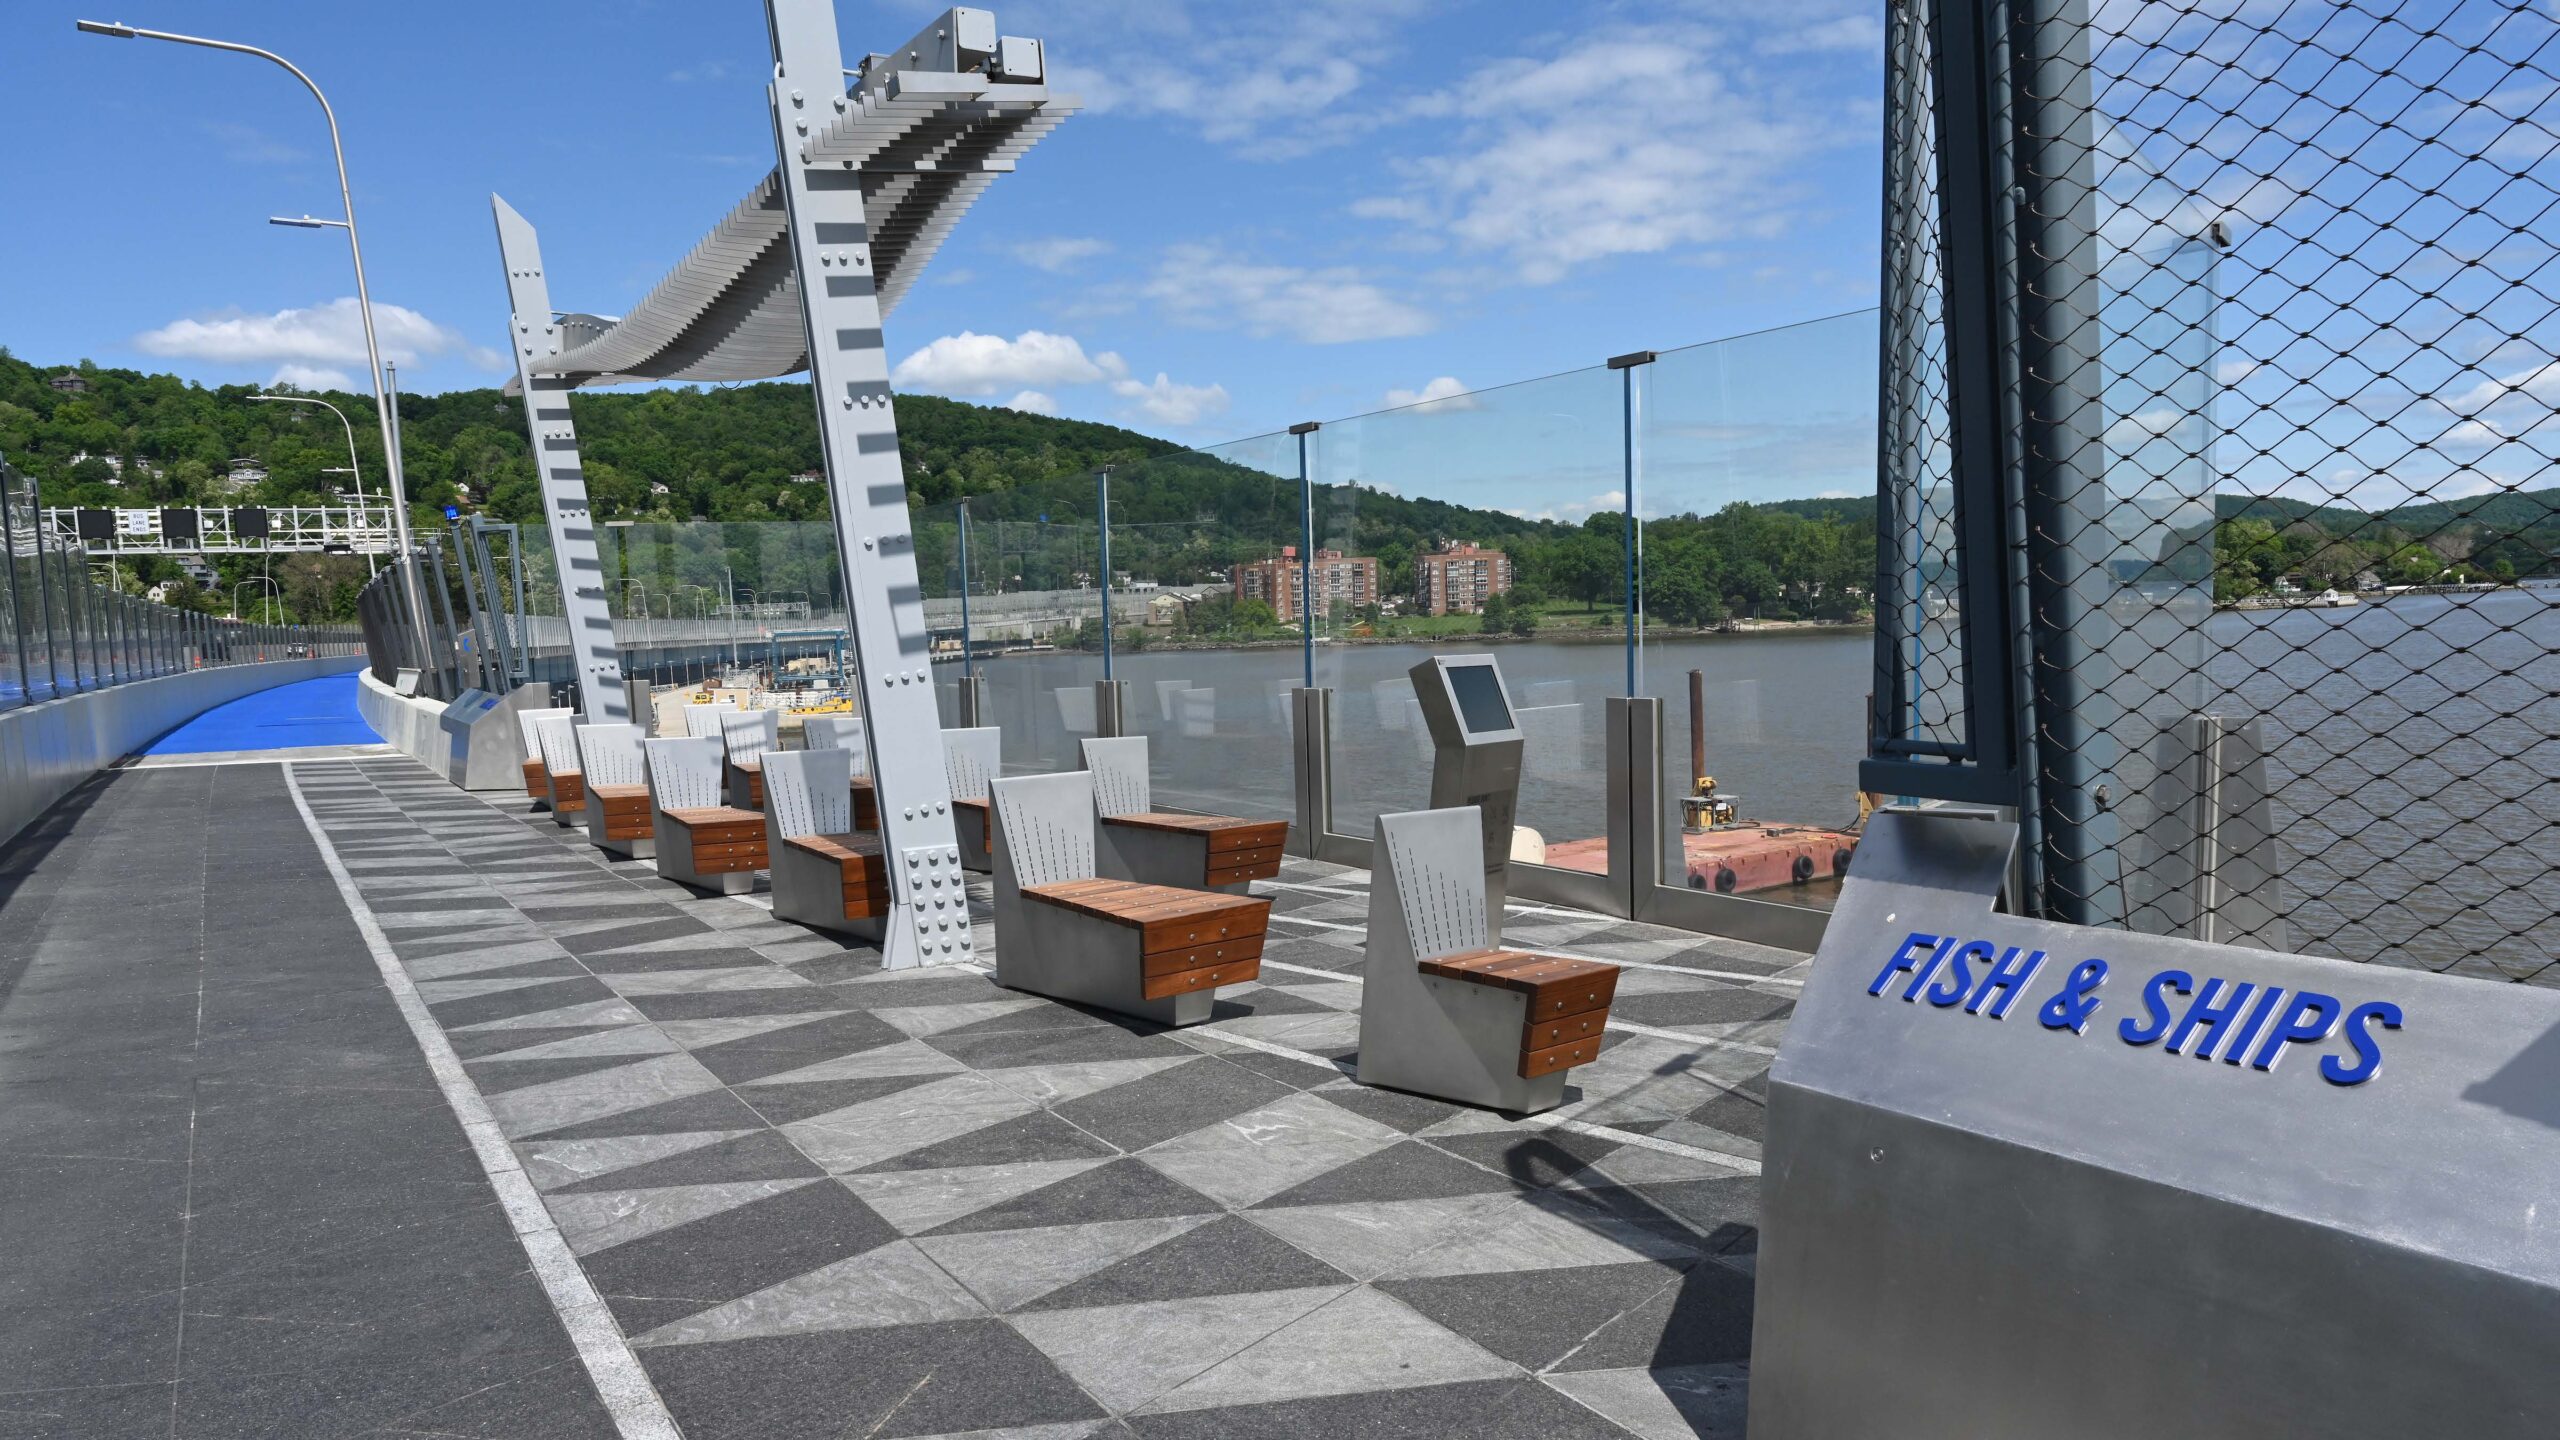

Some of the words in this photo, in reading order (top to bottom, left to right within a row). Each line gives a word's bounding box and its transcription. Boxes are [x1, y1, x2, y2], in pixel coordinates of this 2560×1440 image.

[1868, 931, 2048, 1019] FISH
[2038, 958, 2112, 1034] &
[2118, 969, 2406, 1085] SHIPS
